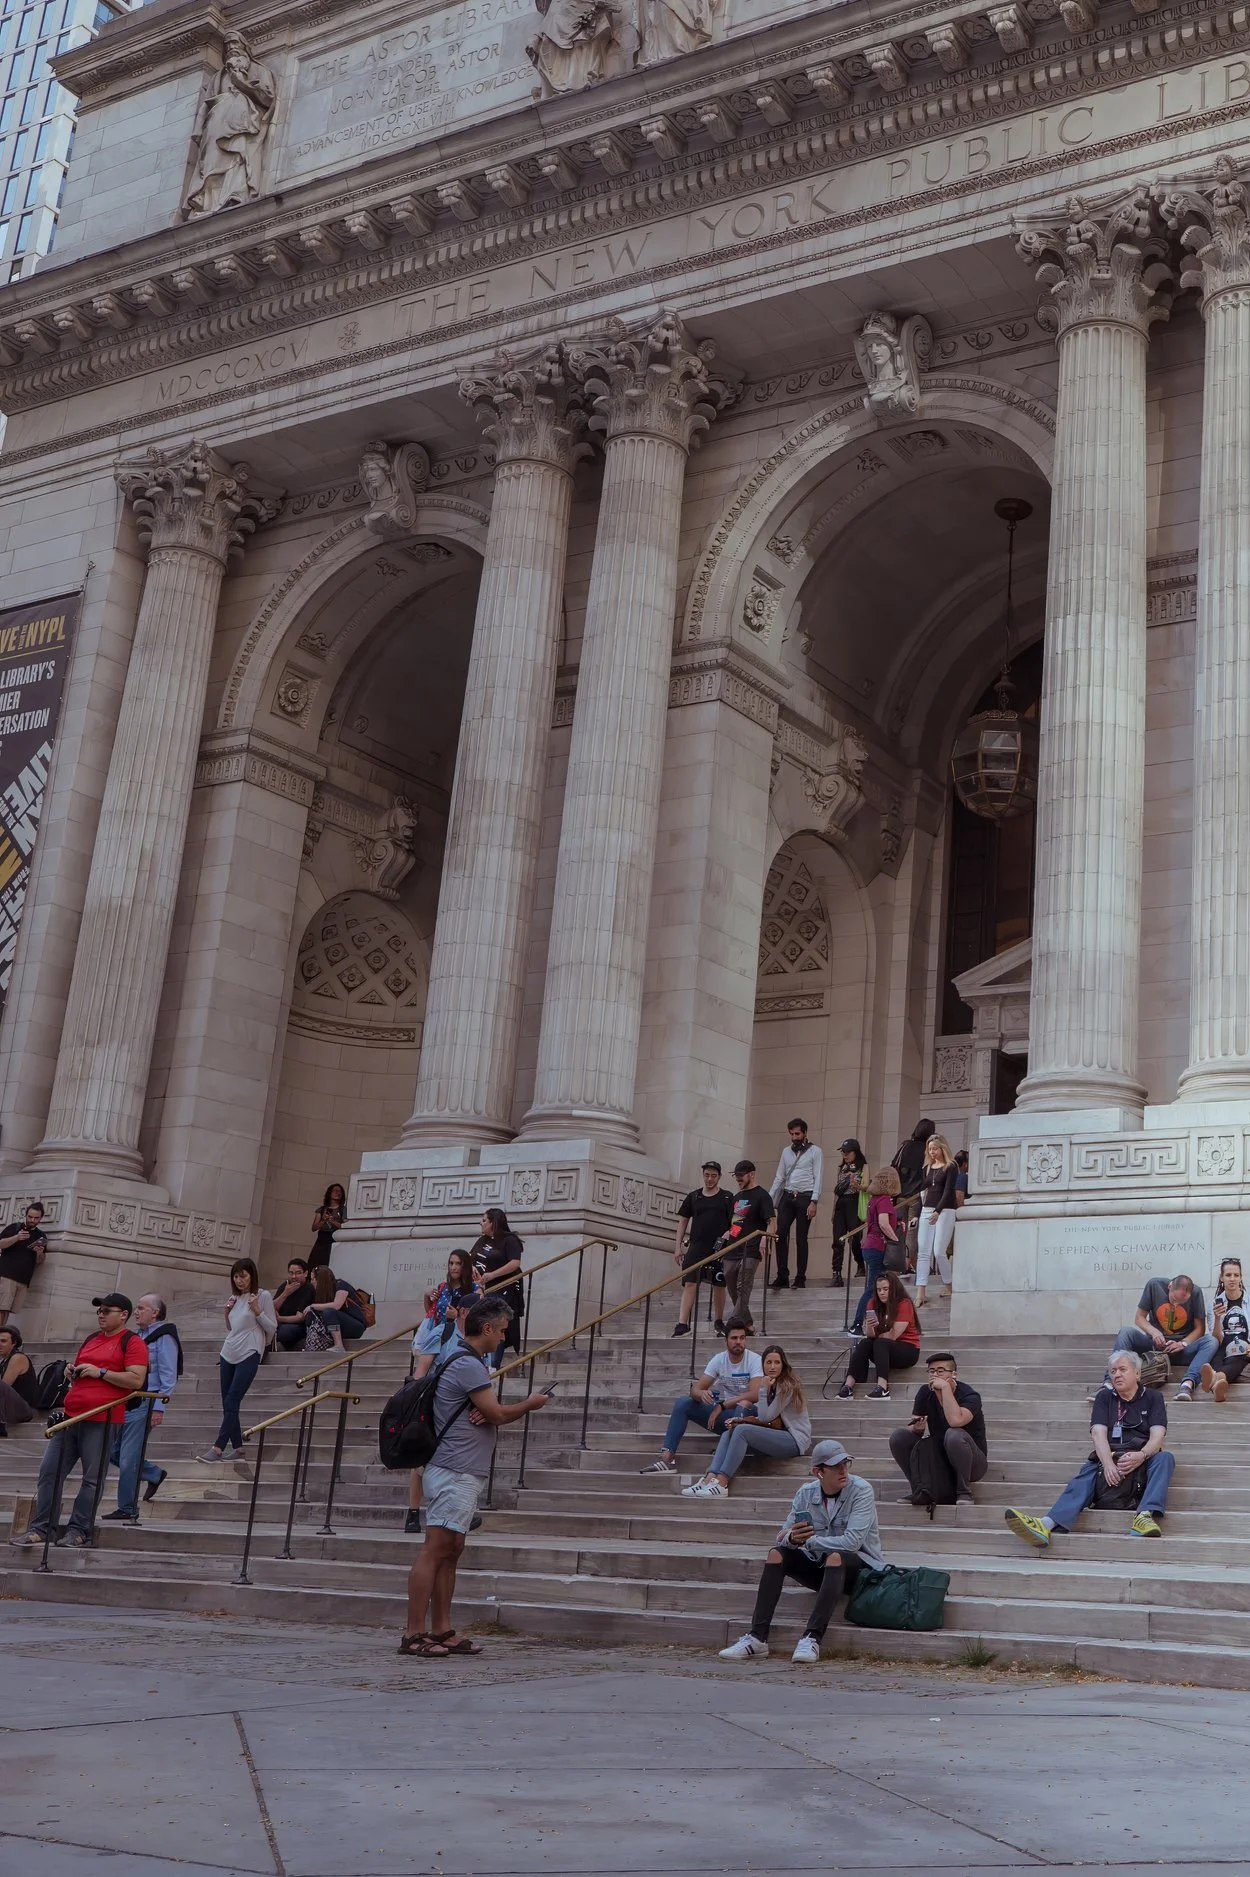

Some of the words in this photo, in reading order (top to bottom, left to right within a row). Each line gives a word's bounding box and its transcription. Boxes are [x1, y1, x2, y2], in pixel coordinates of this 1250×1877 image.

[311, 55, 350, 87] THE
[361, 26, 432, 66] ASTOR
[370, 53, 432, 84] FOUNDED
[448, 41, 464, 55] BY
[330, 85, 376, 115] JOHN
[382, 66, 437, 96] JACOB
[445, 43, 501, 75] ASTOR
[381, 94, 406, 111] FOR
[414, 82, 441, 100] THE
[293, 117, 385, 158] ADVANCEMENT
[386, 107, 403, 125] OF
[455, 64, 535, 102] KNOWLEDGE
[157, 337, 311, 402] MDCCCXCV
[400, 279, 493, 338] THE
[527, 230, 653, 300] NEW
[697, 177, 838, 249] YORK
[882, 106, 1095, 200] PUBLIC
[25, 615, 66, 648] NYPL
[0, 660, 56, 689] LIBRARY'S
[1043, 1244, 1100, 1256] STEPHEN
[1114, 1241, 1206, 1254] SCHWARZMAN
[1093, 1261, 1153, 1272] BUILDING
